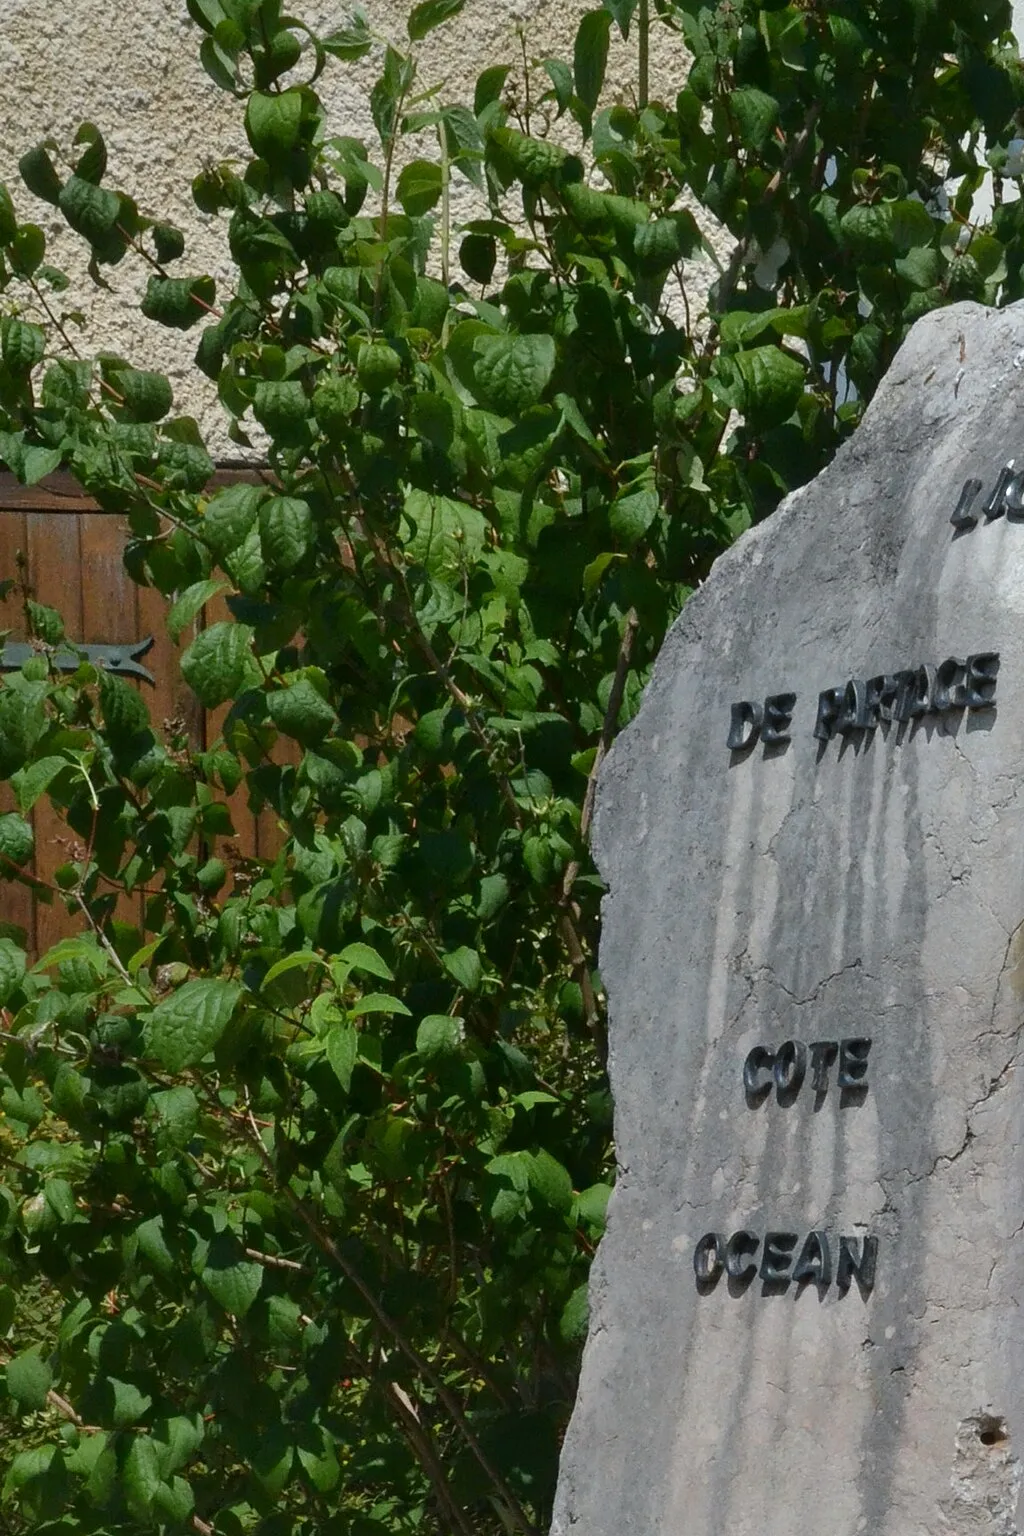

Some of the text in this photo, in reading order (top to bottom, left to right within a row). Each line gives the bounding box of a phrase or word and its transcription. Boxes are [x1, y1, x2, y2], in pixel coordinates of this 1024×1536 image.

[726, 692, 797, 750] DE
[813, 652, 1000, 740] PARTAGE
[743, 1037, 873, 1095] COTE
[693, 1230, 879, 1288] OCEAN
